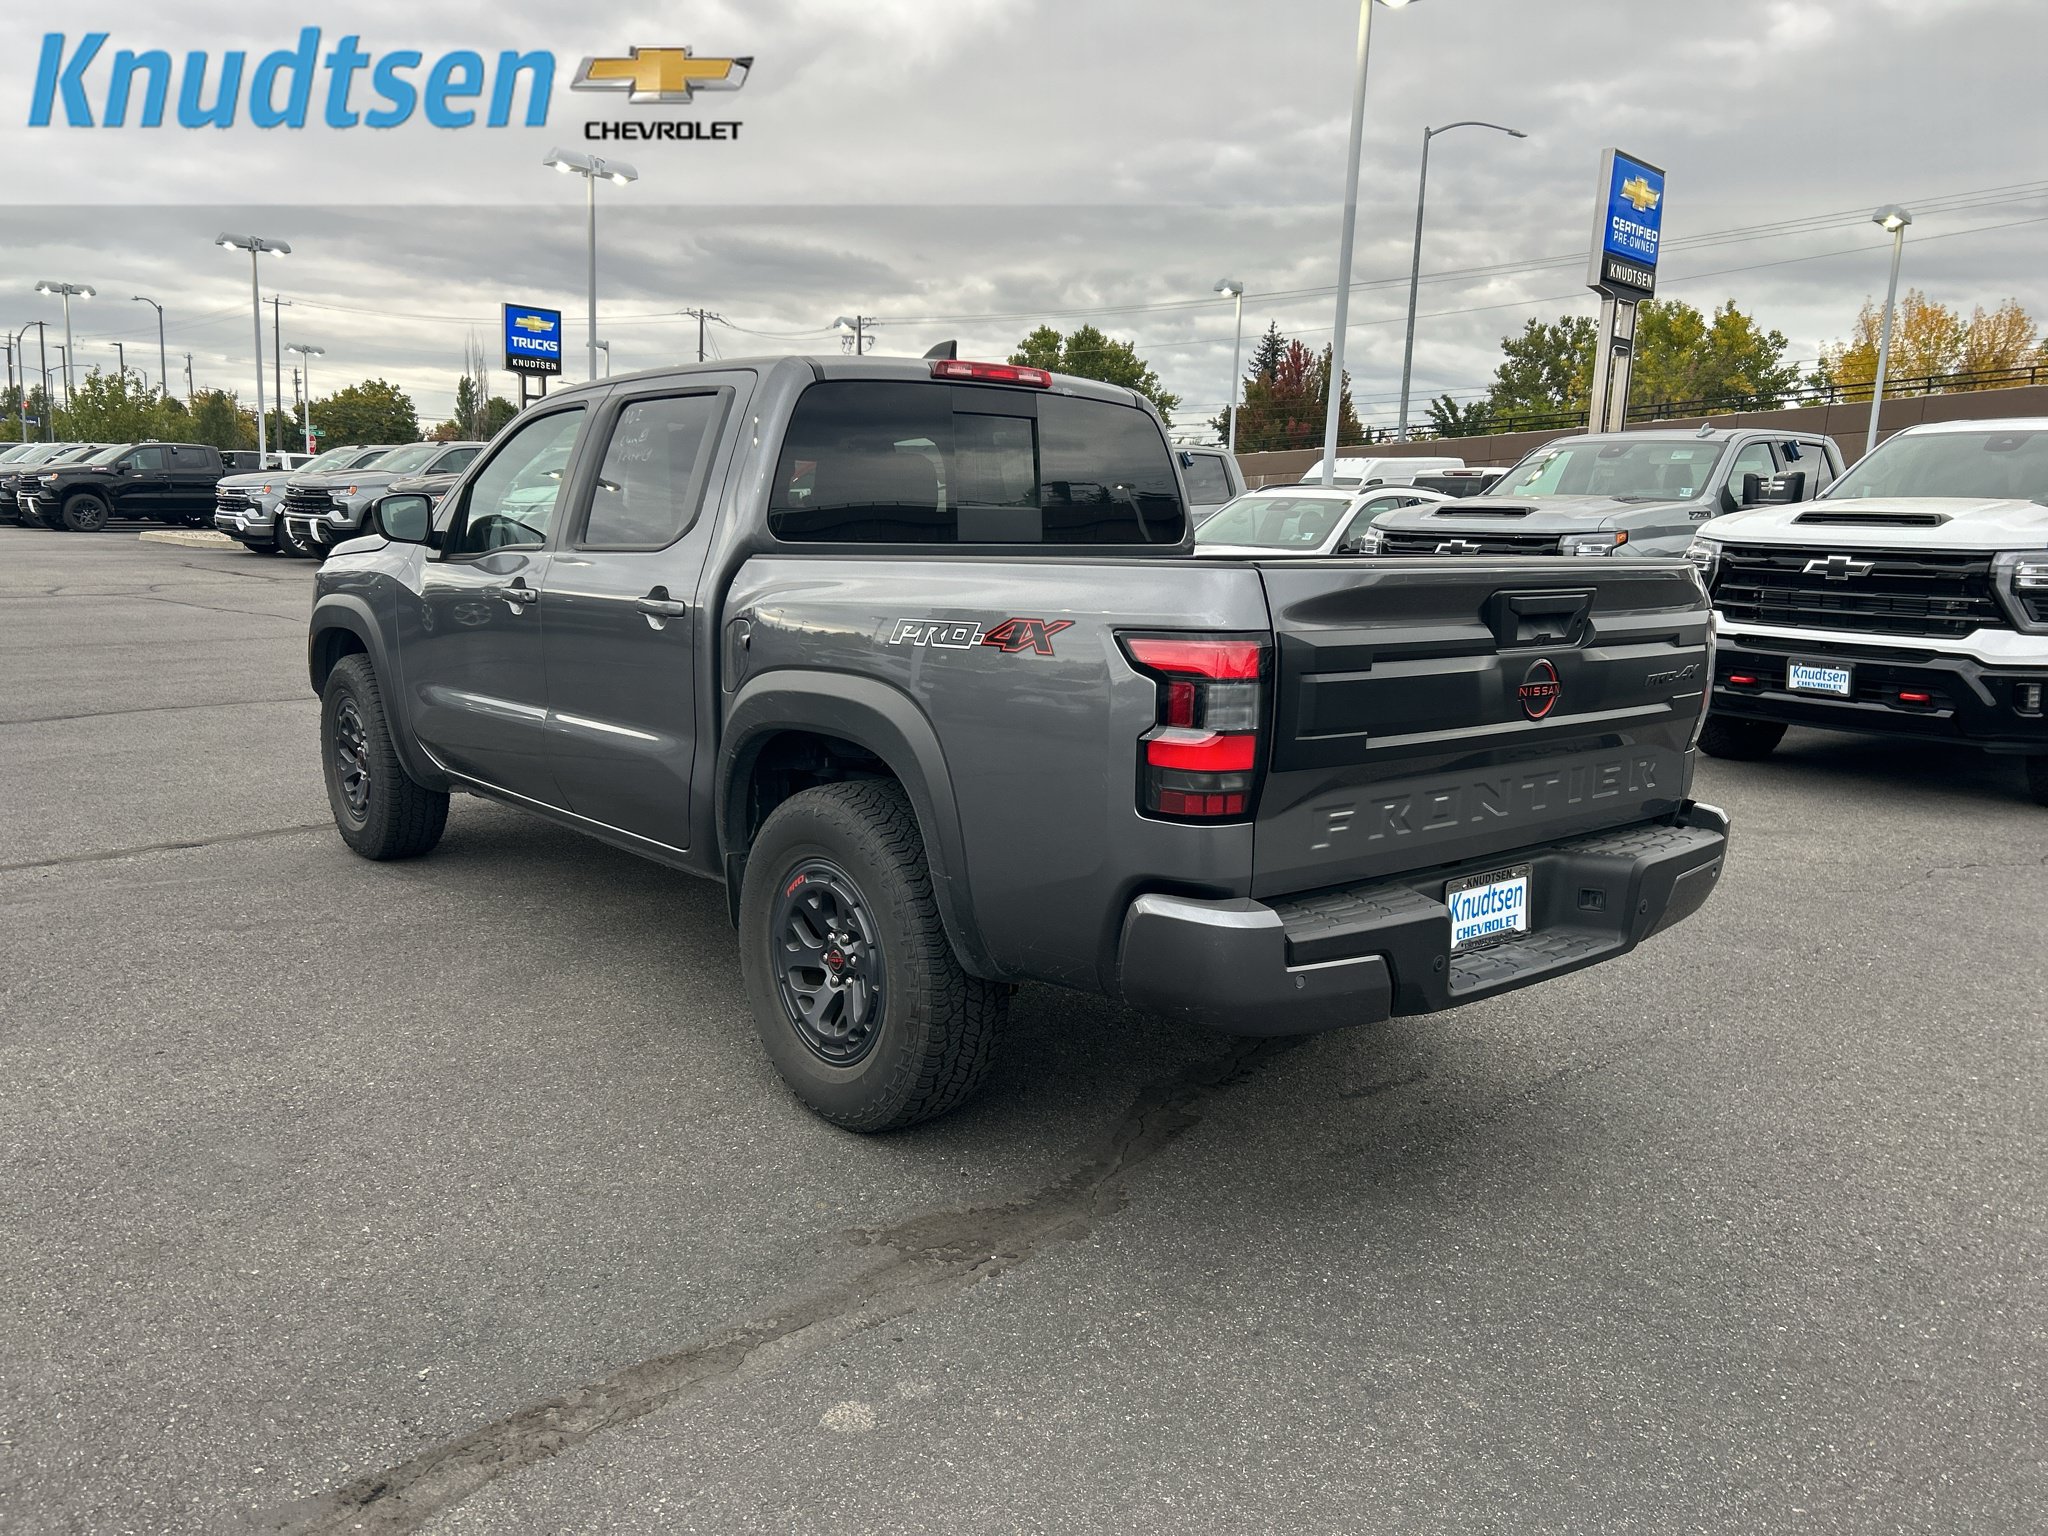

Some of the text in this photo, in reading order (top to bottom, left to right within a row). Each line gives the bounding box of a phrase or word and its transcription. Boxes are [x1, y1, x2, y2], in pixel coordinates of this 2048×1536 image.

[1612, 216, 1658, 242] CERTIFIED
[1613, 231, 1655, 254] PRE-OWNED
[1610, 263, 1653, 288] KNUDTSEN
[511, 336, 558, 352] TRUCKS
[512, 358, 557, 370] KNUDTSEN
[1793, 665, 1847, 683] Knudtsen
[1518, 684, 1561, 698] NISSAN
[1311, 753, 1657, 850] FRONTIER
[1466, 868, 1513, 888] KNUDTSEN
[1452, 885, 1523, 922] Knudtsen
[1456, 914, 1518, 940] CHEVROLET
